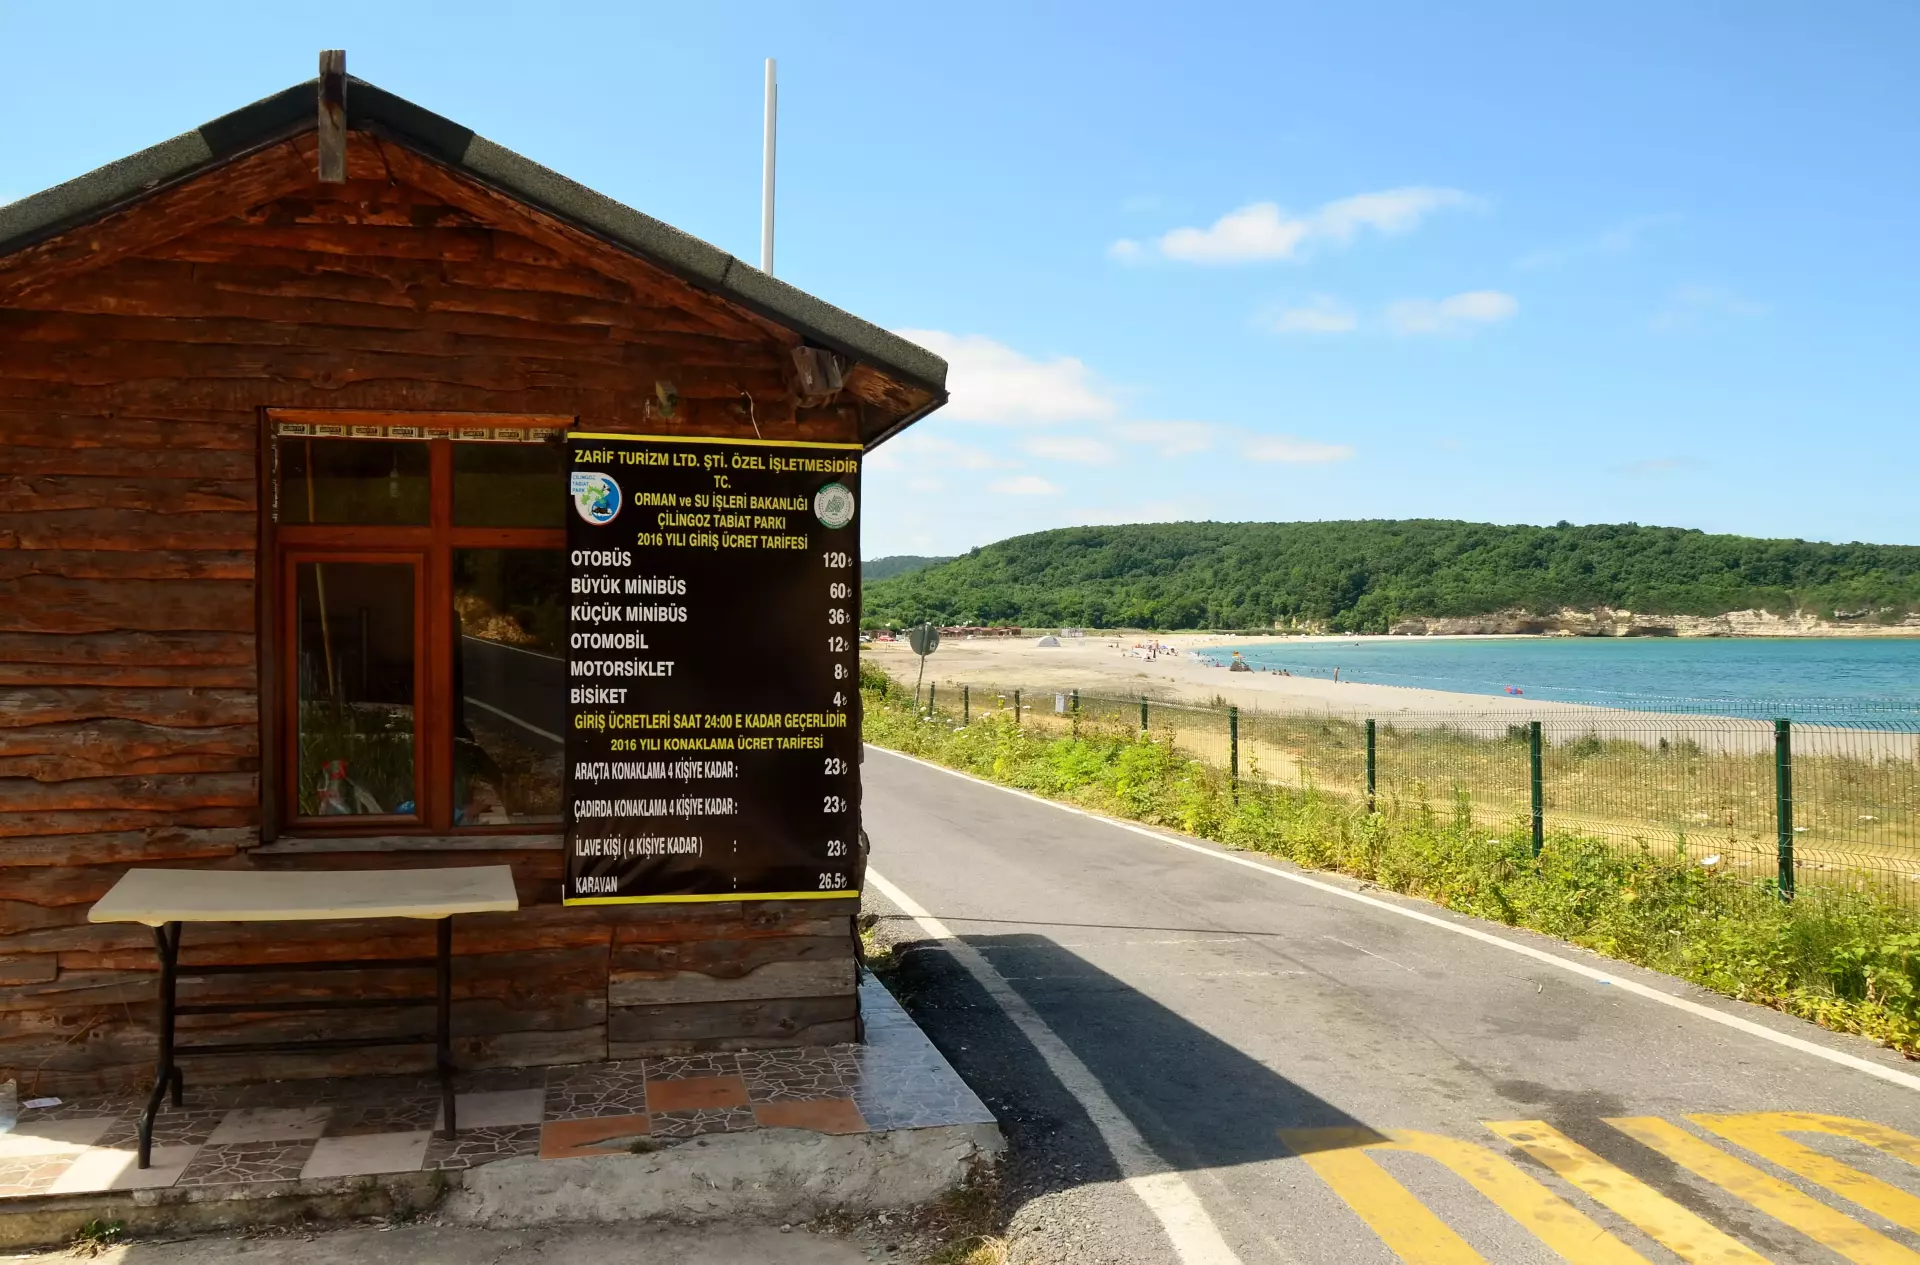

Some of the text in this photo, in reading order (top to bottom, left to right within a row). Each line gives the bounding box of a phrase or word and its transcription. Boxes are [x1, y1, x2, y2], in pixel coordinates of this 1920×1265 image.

[575, 448, 857, 473] ZARİF TURİZM LTD. ŞTİ. ÖZEL İŞLETMESİDİR
[714, 475, 731, 488] TC.
[635, 492, 807, 512] ORMAN ve SU İŞLERİ BAKANLIĞI
[658, 511, 785, 529] ÇİLİNGOZ TABİAT PARKI
[638, 531, 807, 550] 2016 YILI GİRİŞ ÜCRET TARİFESİ
[572, 547, 631, 566] OTOBÜS
[572, 574, 620, 593] BÜYÜK
[625, 575, 686, 595] MİNİBÜS
[572, 602, 621, 625] KÜÇÜK
[626, 603, 687, 622] MİNİBÜS
[571, 630, 648, 649] OTOMOBİL
[571, 657, 674, 676] MOTORSİKLET
[571, 685, 627, 703] BİSİKET
[575, 710, 846, 733] GİRİŞ ÜCRETLERİ SAAT 24:00 E KADAR GEÇERLİDİR
[611, 734, 823, 750] 2016 YILI KONAKLAMA ÜCRET TARİFESİ
[575, 762, 609, 784] ARAÇTA
[612, 762, 666, 779] KONAKLAMA
[668, 763, 673, 778] 4
[675, 757, 702, 783] KİŞİYE
[574, 800, 612, 822] ÇADIRDA
[615, 799, 667, 817] KONAKLAMA
[669, 800, 674, 815] 4
[676, 794, 703, 820] KİŞİYE
[576, 835, 601, 856] İLAVE
[604, 834, 621, 860] KİŞİ
[637, 833, 665, 859] KİŞİYE
[576, 876, 617, 893] KARAVAN
